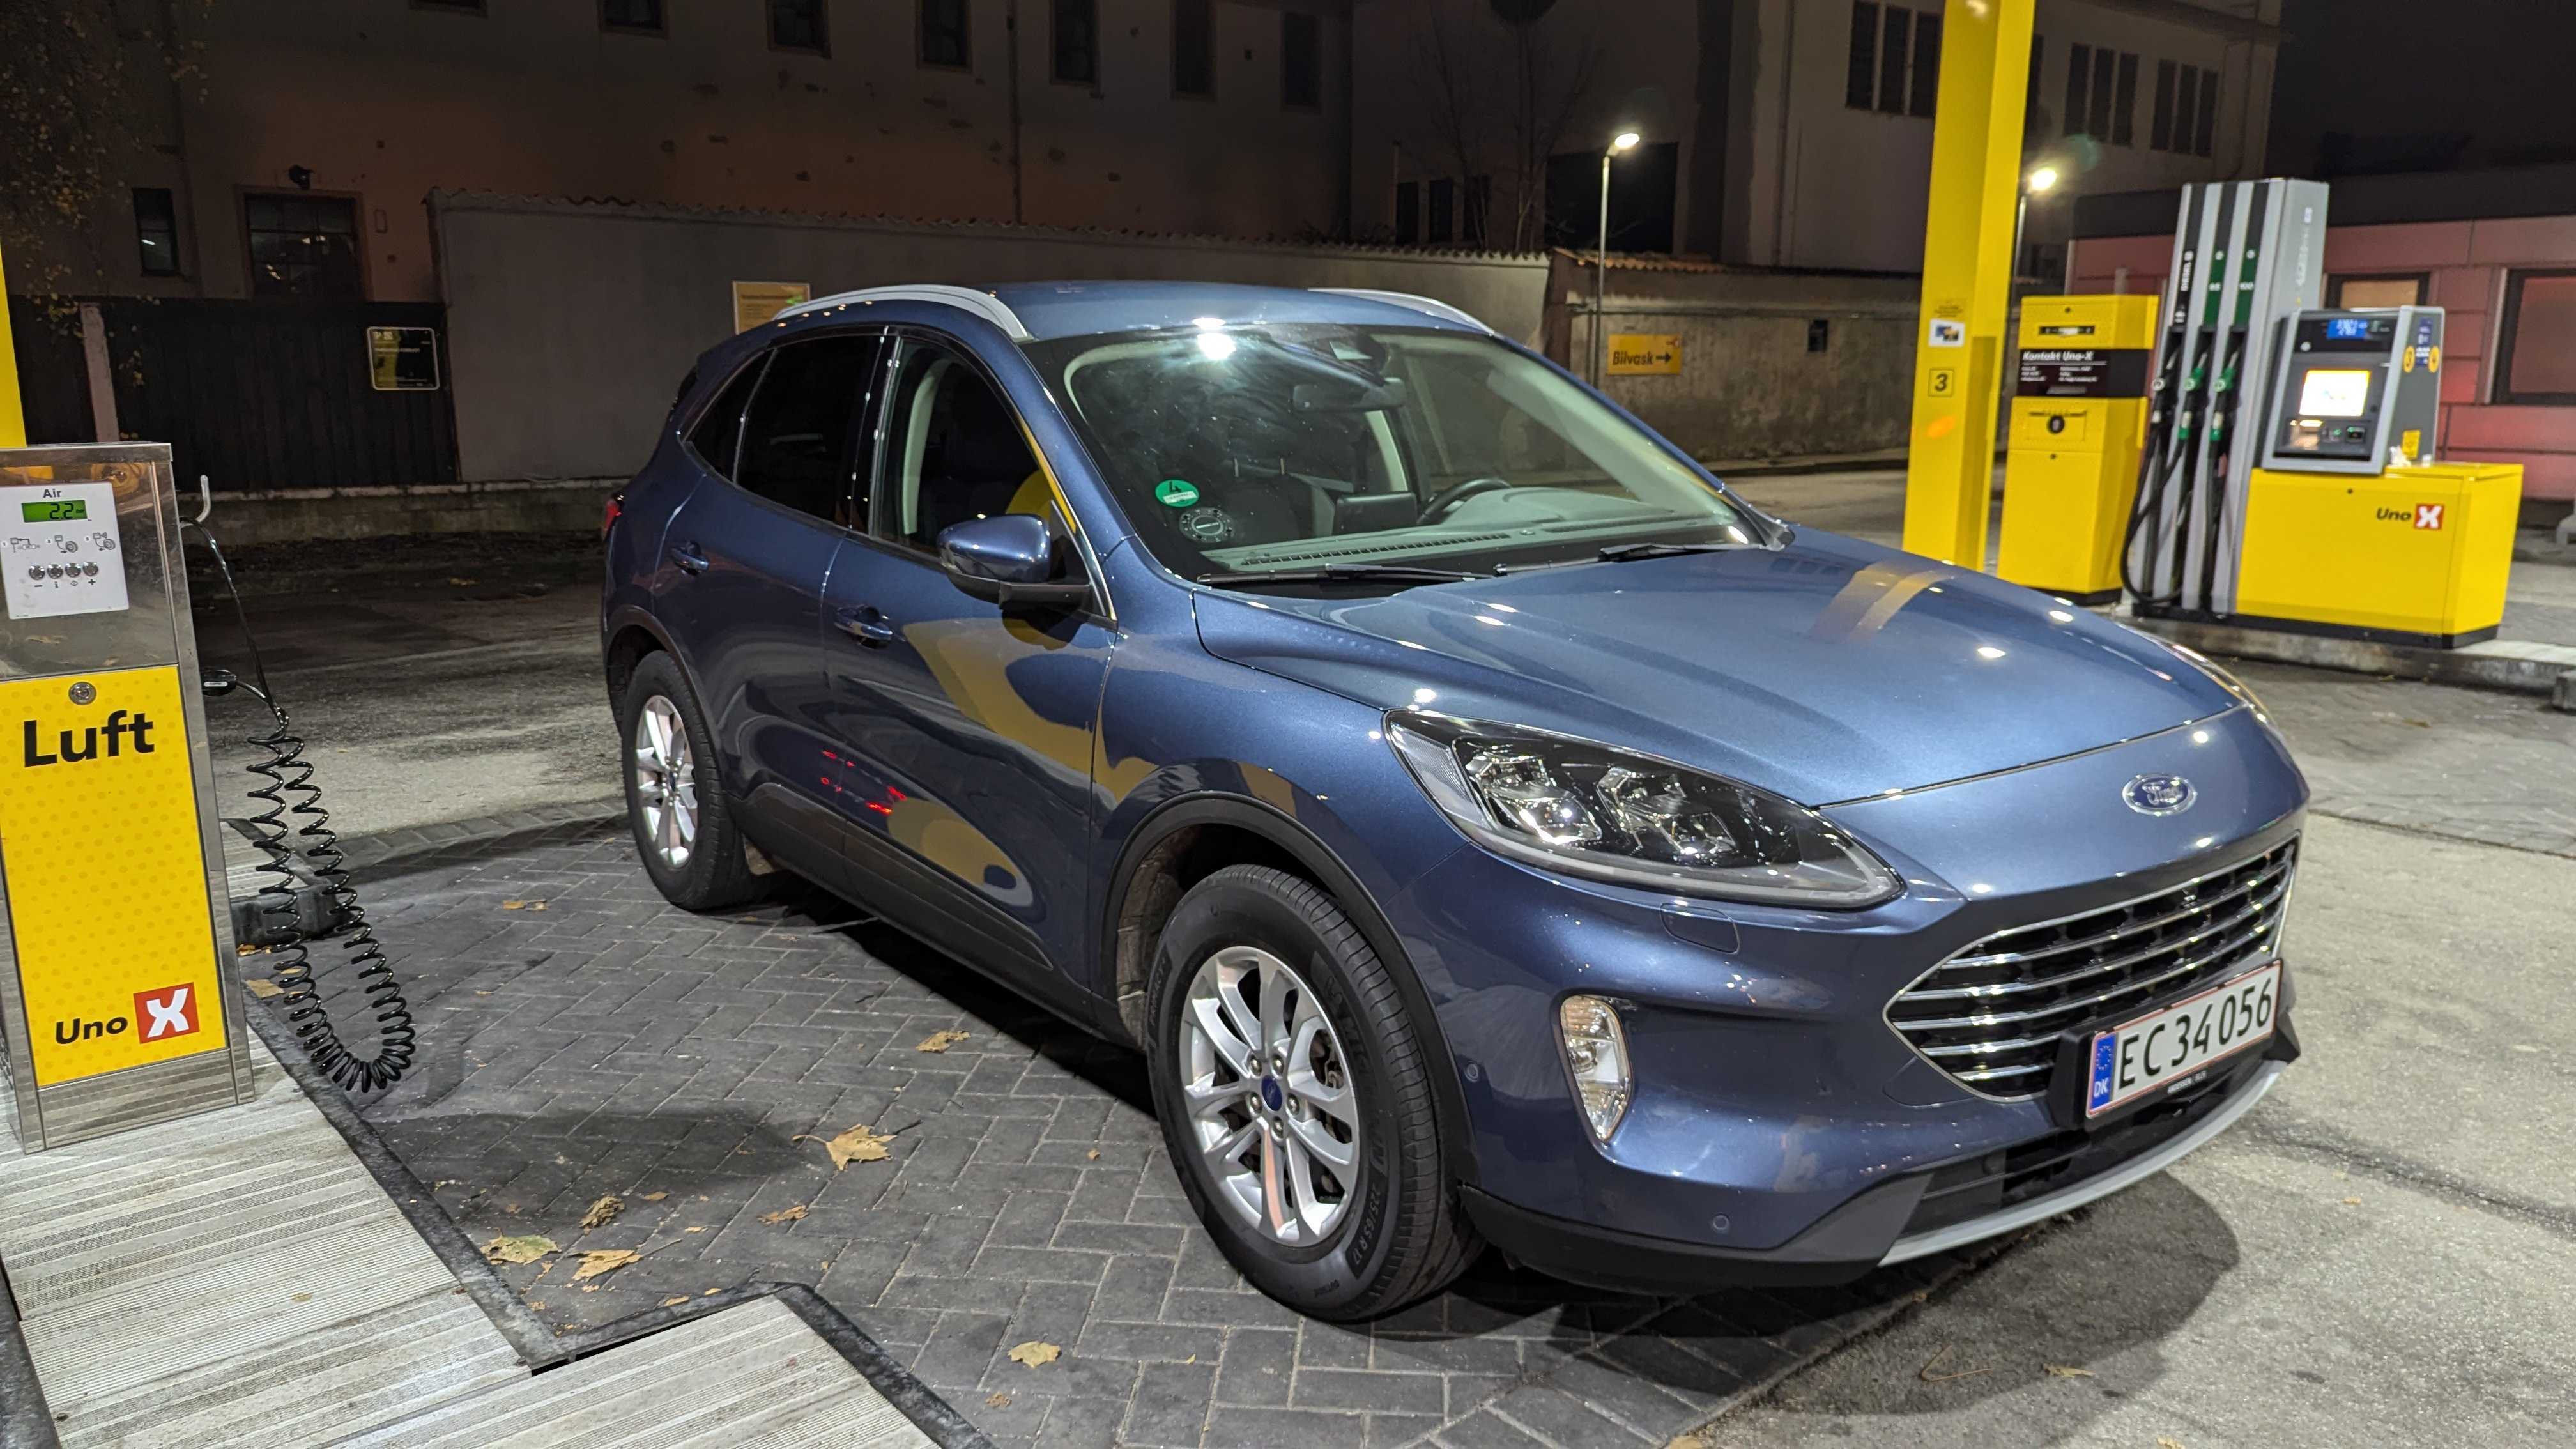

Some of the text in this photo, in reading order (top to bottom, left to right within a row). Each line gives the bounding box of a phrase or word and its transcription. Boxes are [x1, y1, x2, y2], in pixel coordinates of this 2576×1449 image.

[1612, 351, 1654, 365] Bilvask
[2023, 351, 2094, 361] Kontakt Uno-X
[1934, 372, 1949, 392] 3
[43, 488, 62, 498] Air
[50, 502, 74, 519] 2.2
[2376, 505, 2442, 529] Uno X
[23, 710, 155, 767] Luft
[55, 988, 190, 1045] Uno X
[2119, 977, 2273, 1090] EC 34 056
[2093, 1077, 2109, 1099] DK
